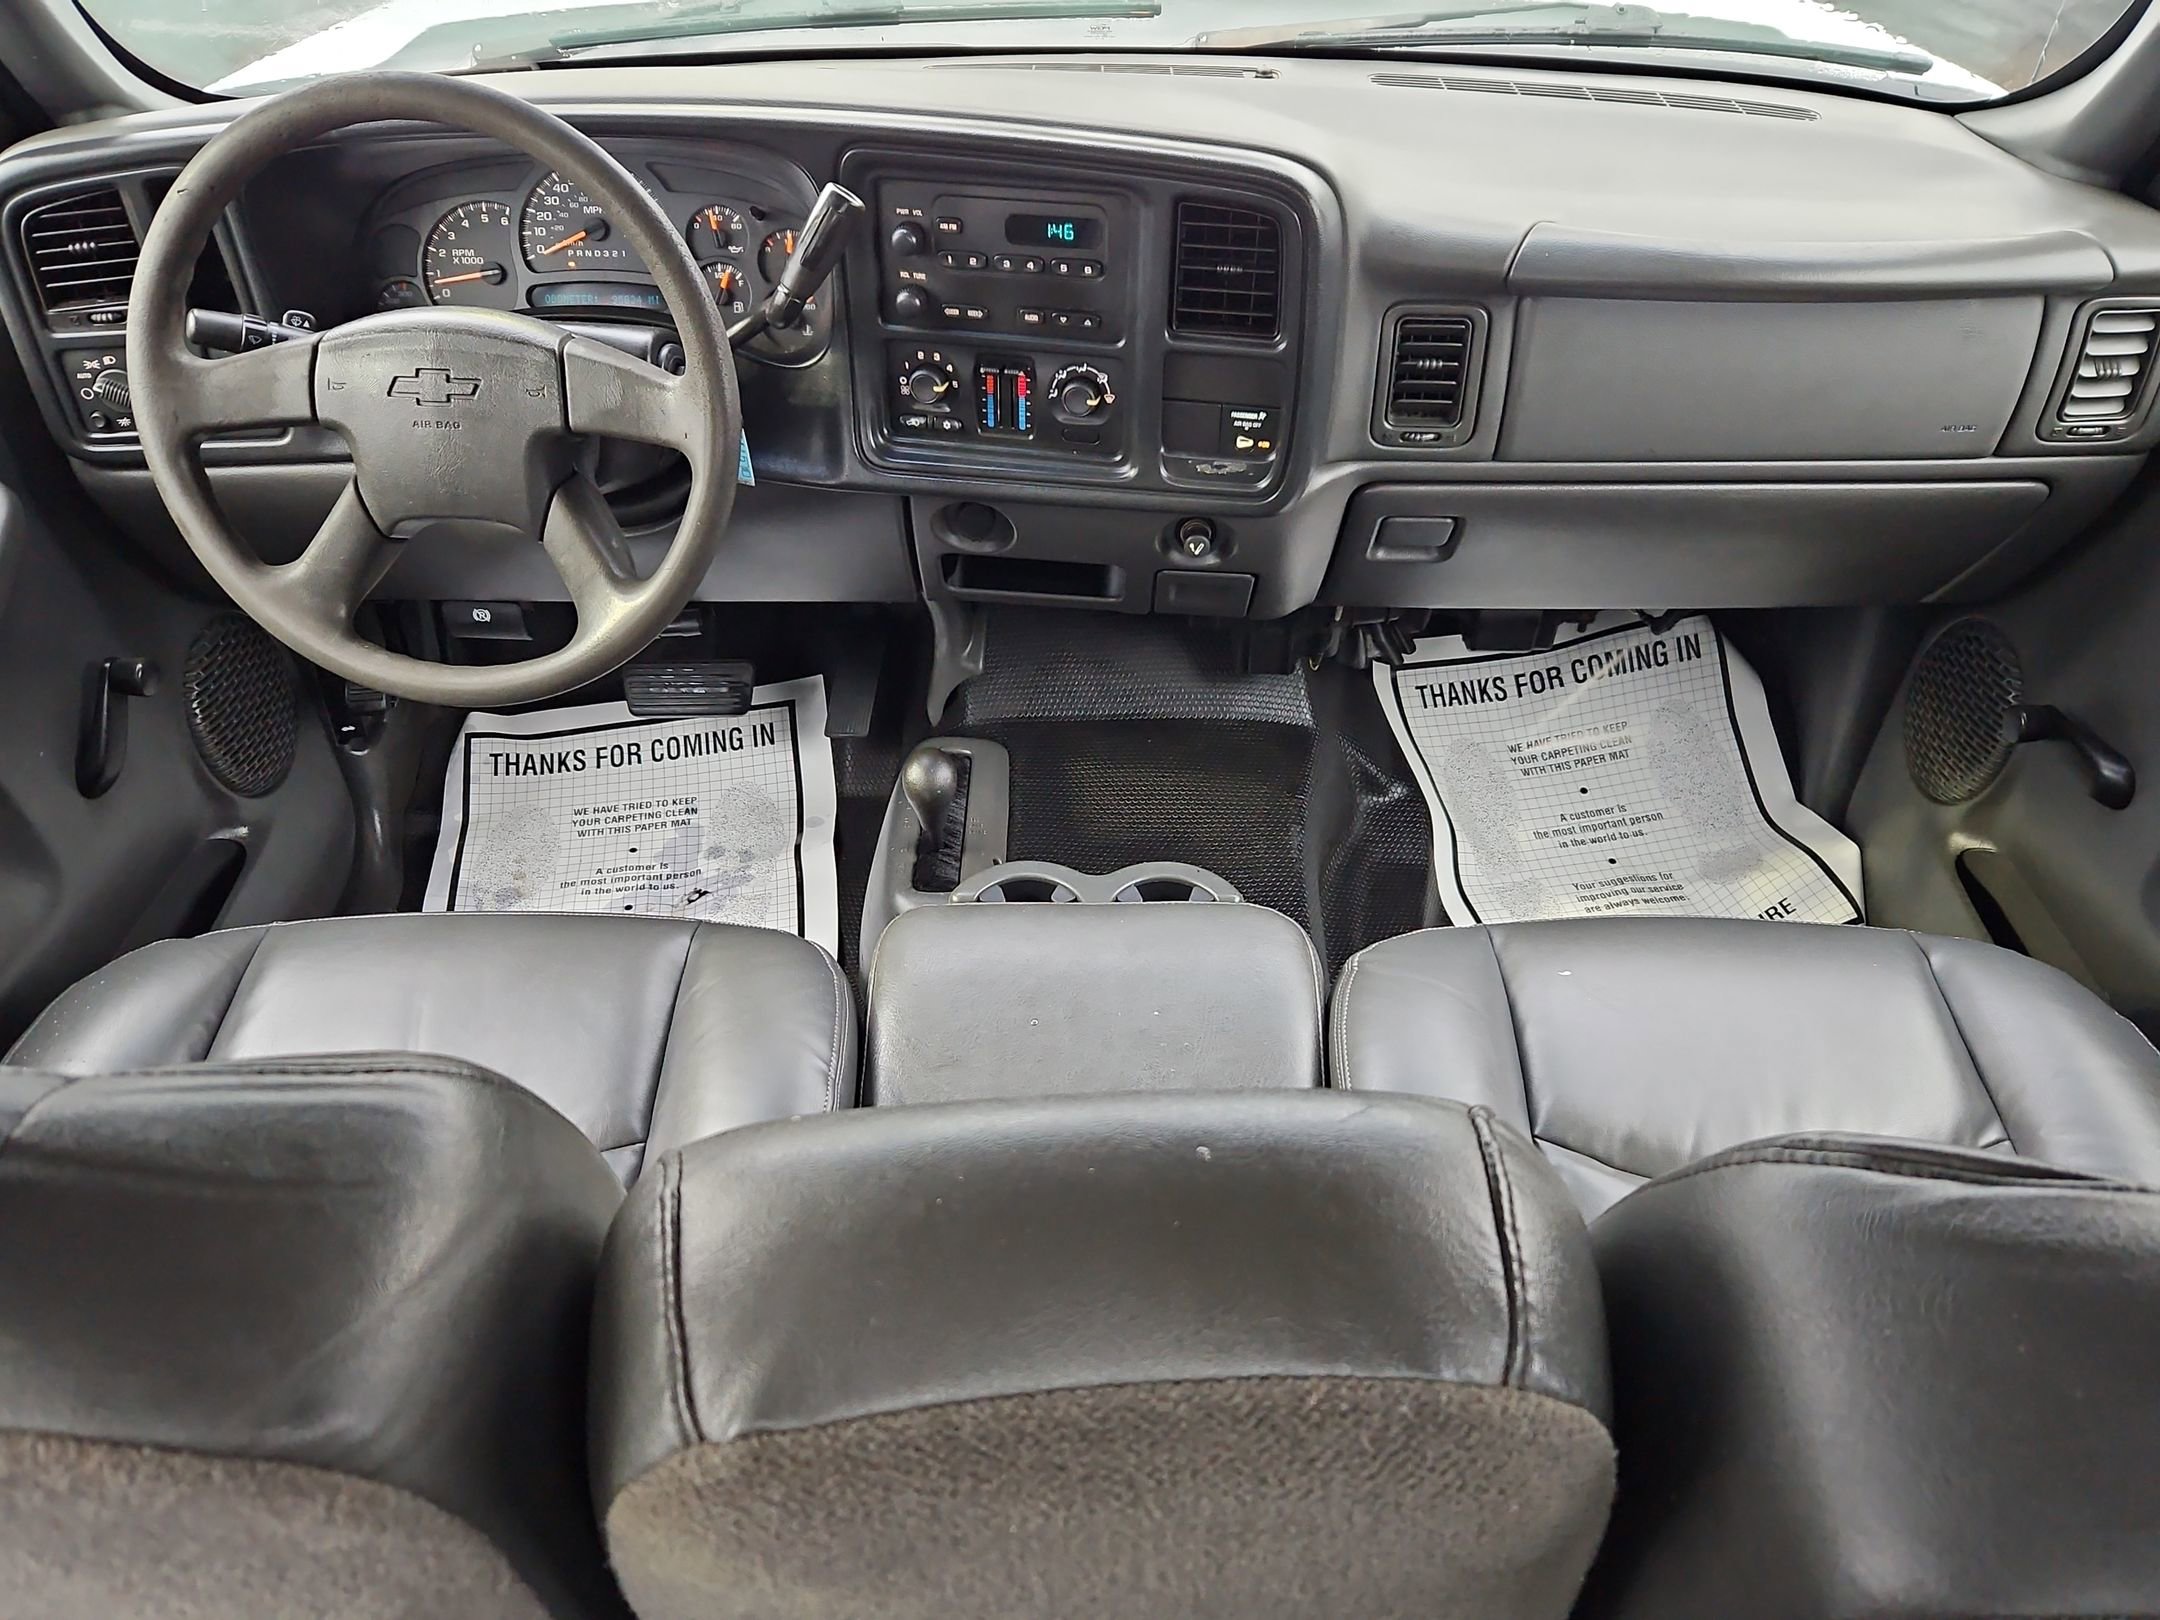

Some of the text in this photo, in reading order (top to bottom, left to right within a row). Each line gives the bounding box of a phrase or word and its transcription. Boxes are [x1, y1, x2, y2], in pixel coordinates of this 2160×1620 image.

[552, 183, 569, 193] 40
[543, 196, 560, 205] 30
[481, 214, 489, 223] 5
[536, 212, 552, 221] 20
[461, 220, 469, 228] 4
[500, 217, 509, 226] 6
[693, 222, 700, 230] 0
[447, 232, 456, 240] 3
[534, 227, 546, 236] 10
[438, 249, 446, 257] 2
[452, 249, 475, 257] RPM
[536, 245, 545, 254] 0
[453, 257, 484, 265] X1000
[969, 257, 977, 266] 2
[1003, 260, 1010, 268] 3
[1027, 261, 1034, 270] 4
[442, 289, 451, 297] 0
[917, 351, 925, 360] 2
[933, 352, 940, 361] 3
[946, 364, 953, 373] 4
[412, 420, 461, 430] AIR BAG
[1415, 633, 1701, 709] THANKS FOR COMING IN
[1507, 743, 1523, 753] WE
[1526, 737, 1552, 749] HAVE
[1586, 727, 1600, 736] TO
[1602, 721, 1628, 734] KEEP
[489, 722, 775, 776] THANKS FOR COMING IN
[1510, 735, 1632, 765] YOUR CARPETING CLEAN
[1520, 749, 1630, 776] WITH THIS PAPER MAT
[574, 797, 697, 816] WE HAVE TRIED TO KEEP
[572, 807, 698, 827] YOUR CARPETING CLEAN
[1560, 804, 1627, 822] A customer is
[577, 818, 692, 837] WITH THIS PAPER MAT
[1533, 812, 1664, 840] the most important person
[1559, 840, 1568, 849] in
[1570, 837, 1587, 847] the
[1589, 832, 1617, 844] world
[1619, 831, 1629, 840] to
[606, 863, 656, 874] customer
[560, 868, 702, 889] the most important person
[1572, 872, 1673, 891] Your suggestions for
[595, 887, 611, 895] the
[615, 883, 646, 893] world
[649, 883, 659, 891] to
[663, 882, 679, 890] us.
[1576, 883, 1684, 903] improving our service
[1584, 905, 1602, 914] are
[1604, 897, 1640, 912] always
